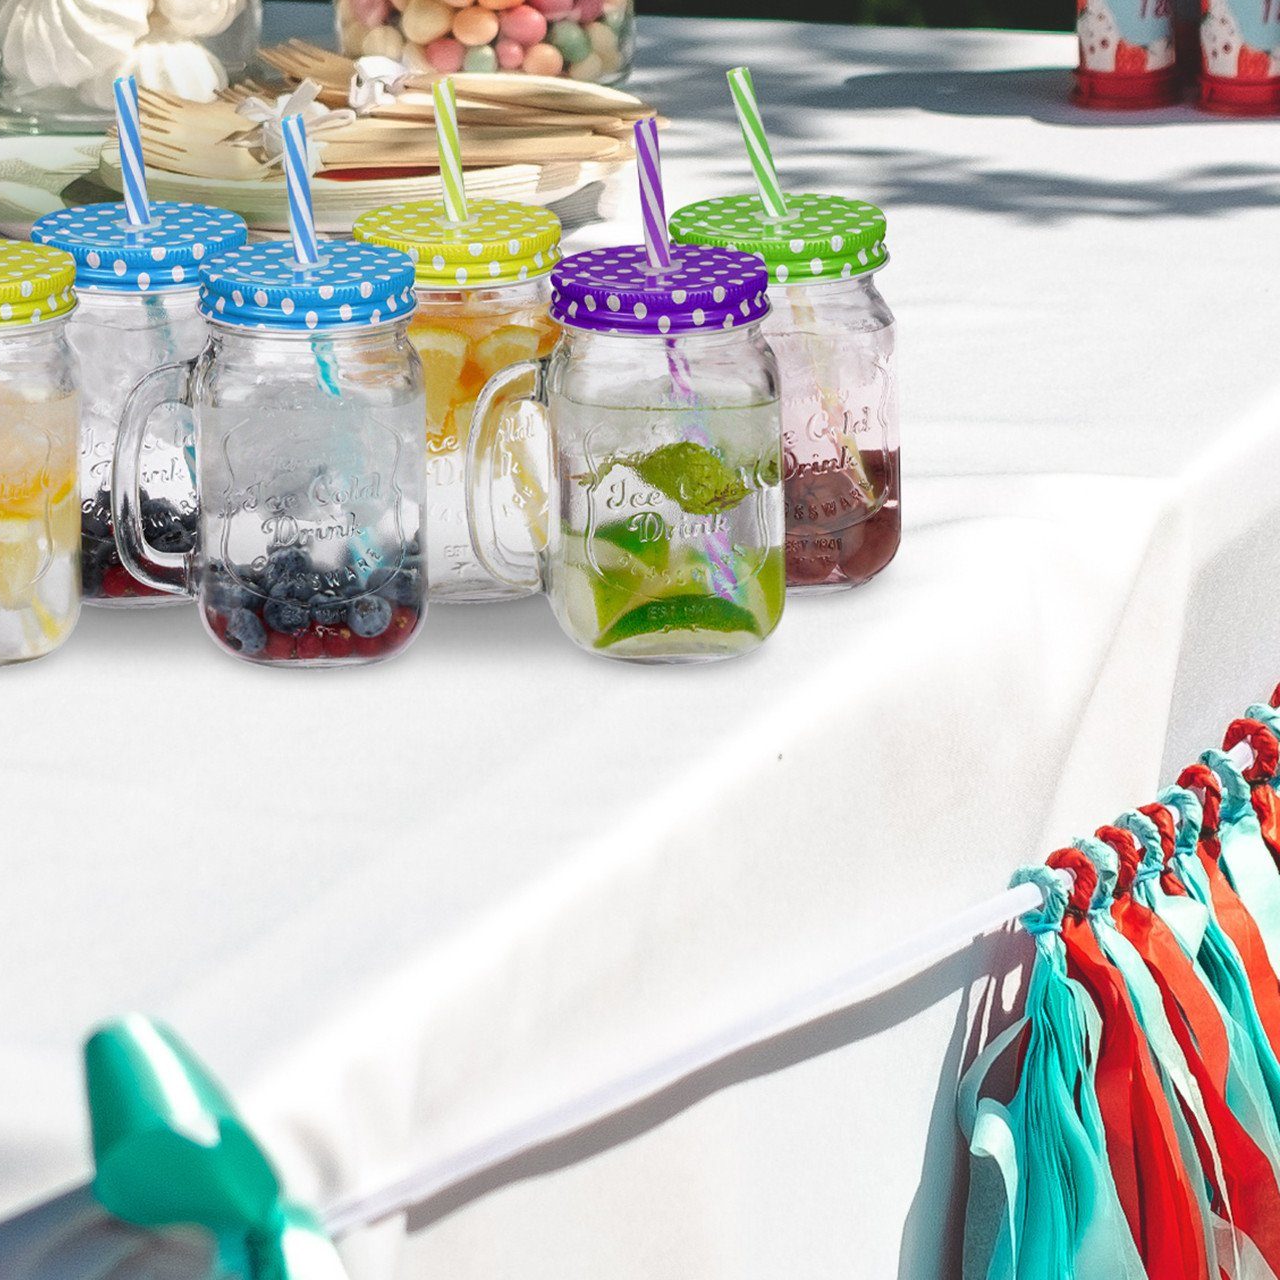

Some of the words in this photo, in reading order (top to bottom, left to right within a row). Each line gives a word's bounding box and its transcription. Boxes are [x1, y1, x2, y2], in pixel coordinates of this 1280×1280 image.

[90, 456, 185, 492] Dink
[308, 471, 382, 507] Cold
[606, 478, 663, 509] Ice
[261, 511, 365, 547] Drink
[628, 510, 729, 543] Drink
